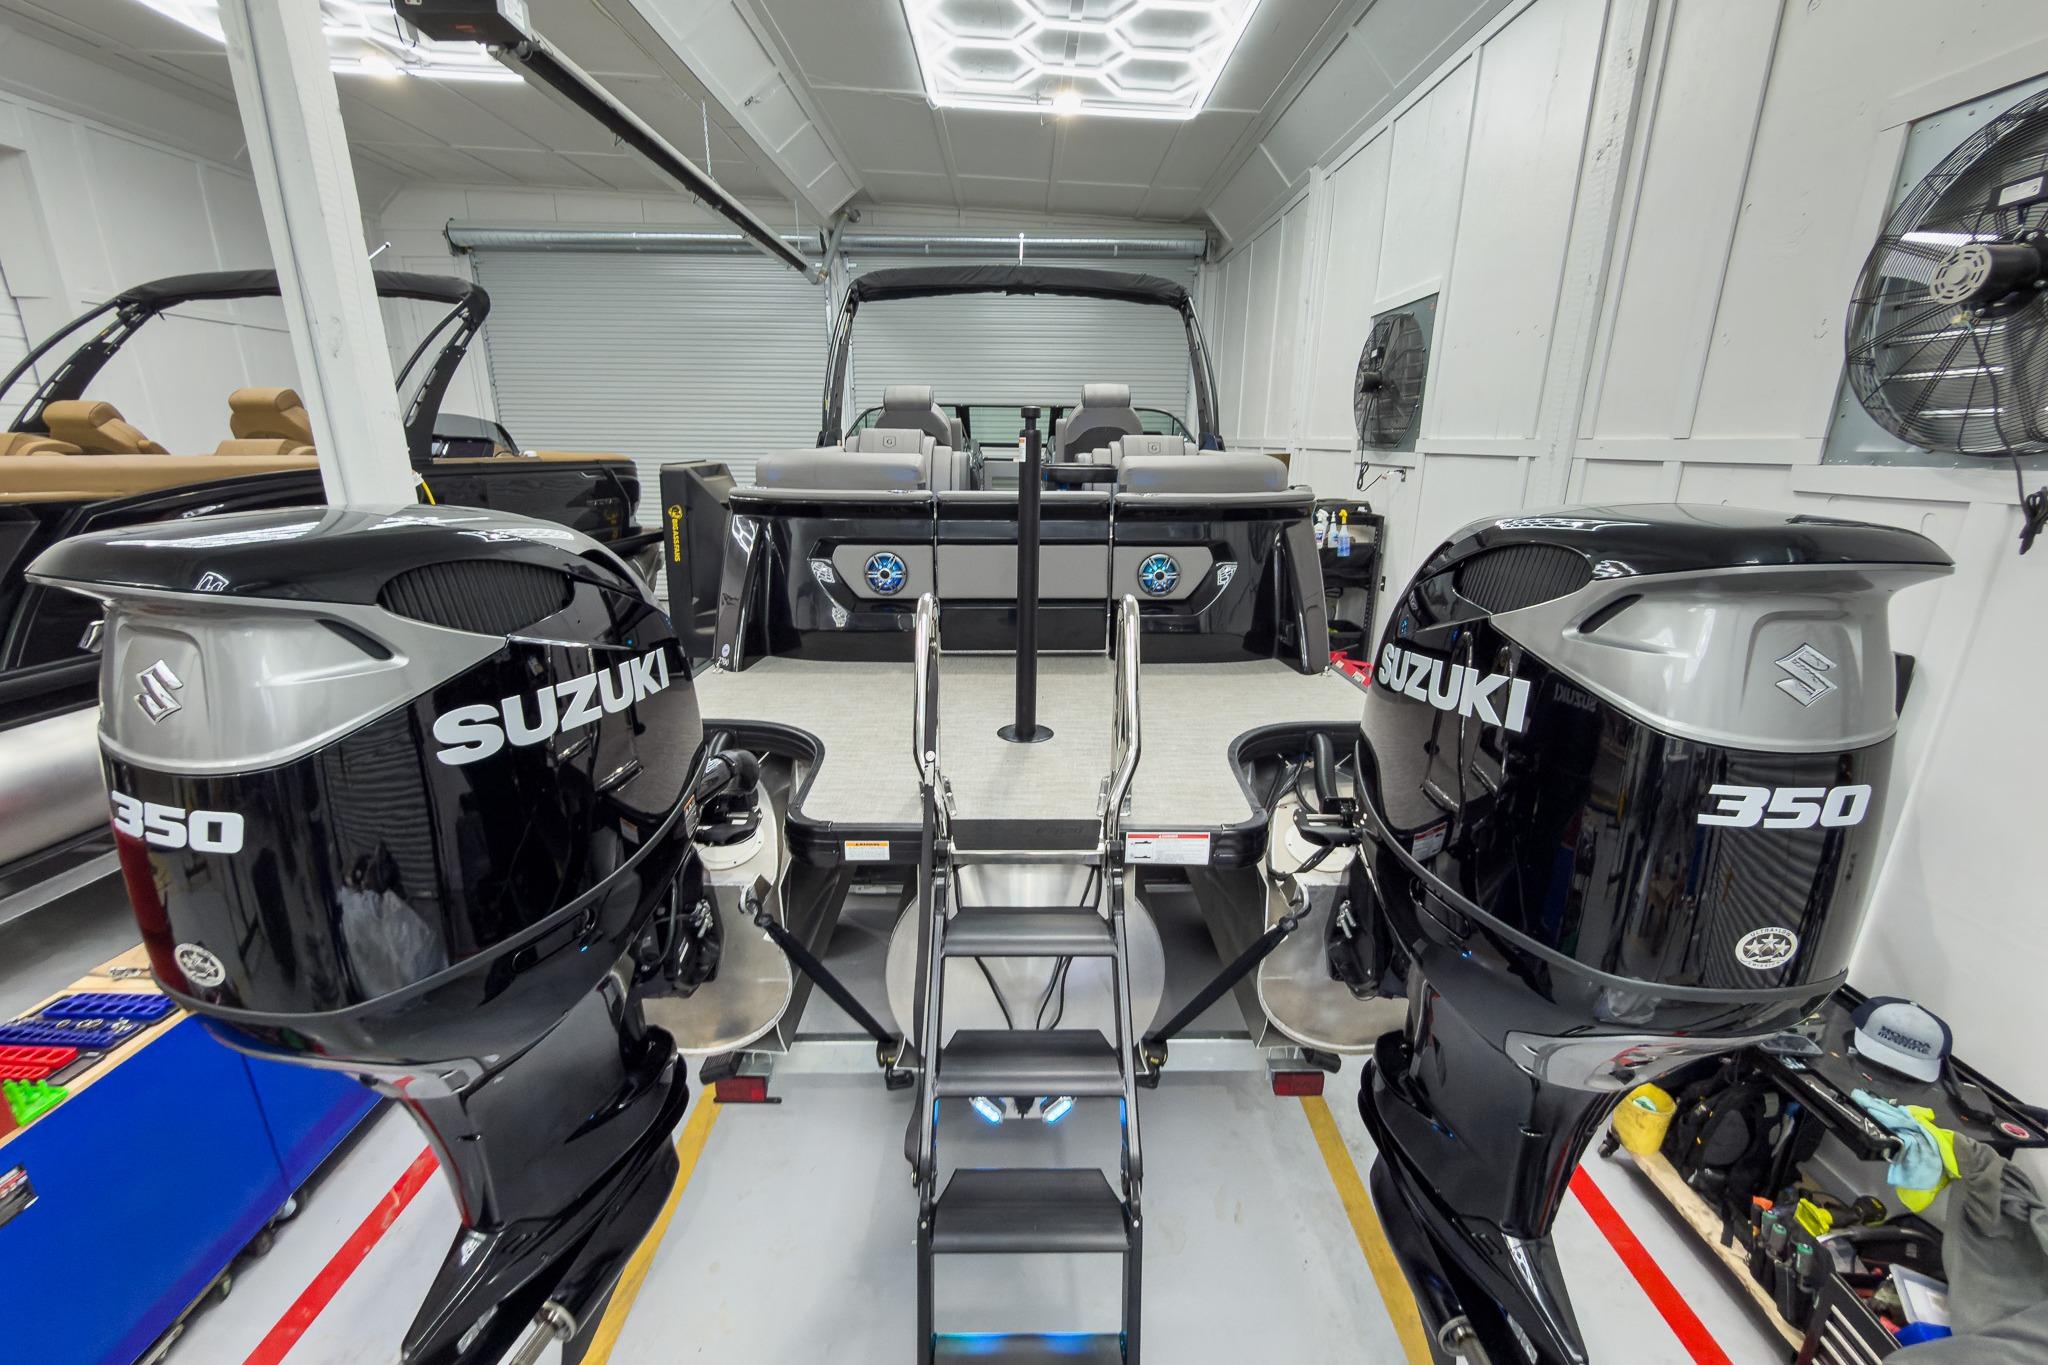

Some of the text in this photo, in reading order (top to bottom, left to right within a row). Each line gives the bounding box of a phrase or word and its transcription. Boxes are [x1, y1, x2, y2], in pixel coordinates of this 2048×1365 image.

[433, 647, 670, 765] SUZUKI
[1378, 643, 1531, 733] SUZUKI
[111, 790, 245, 854] 350
[1697, 784, 1872, 829] 350
